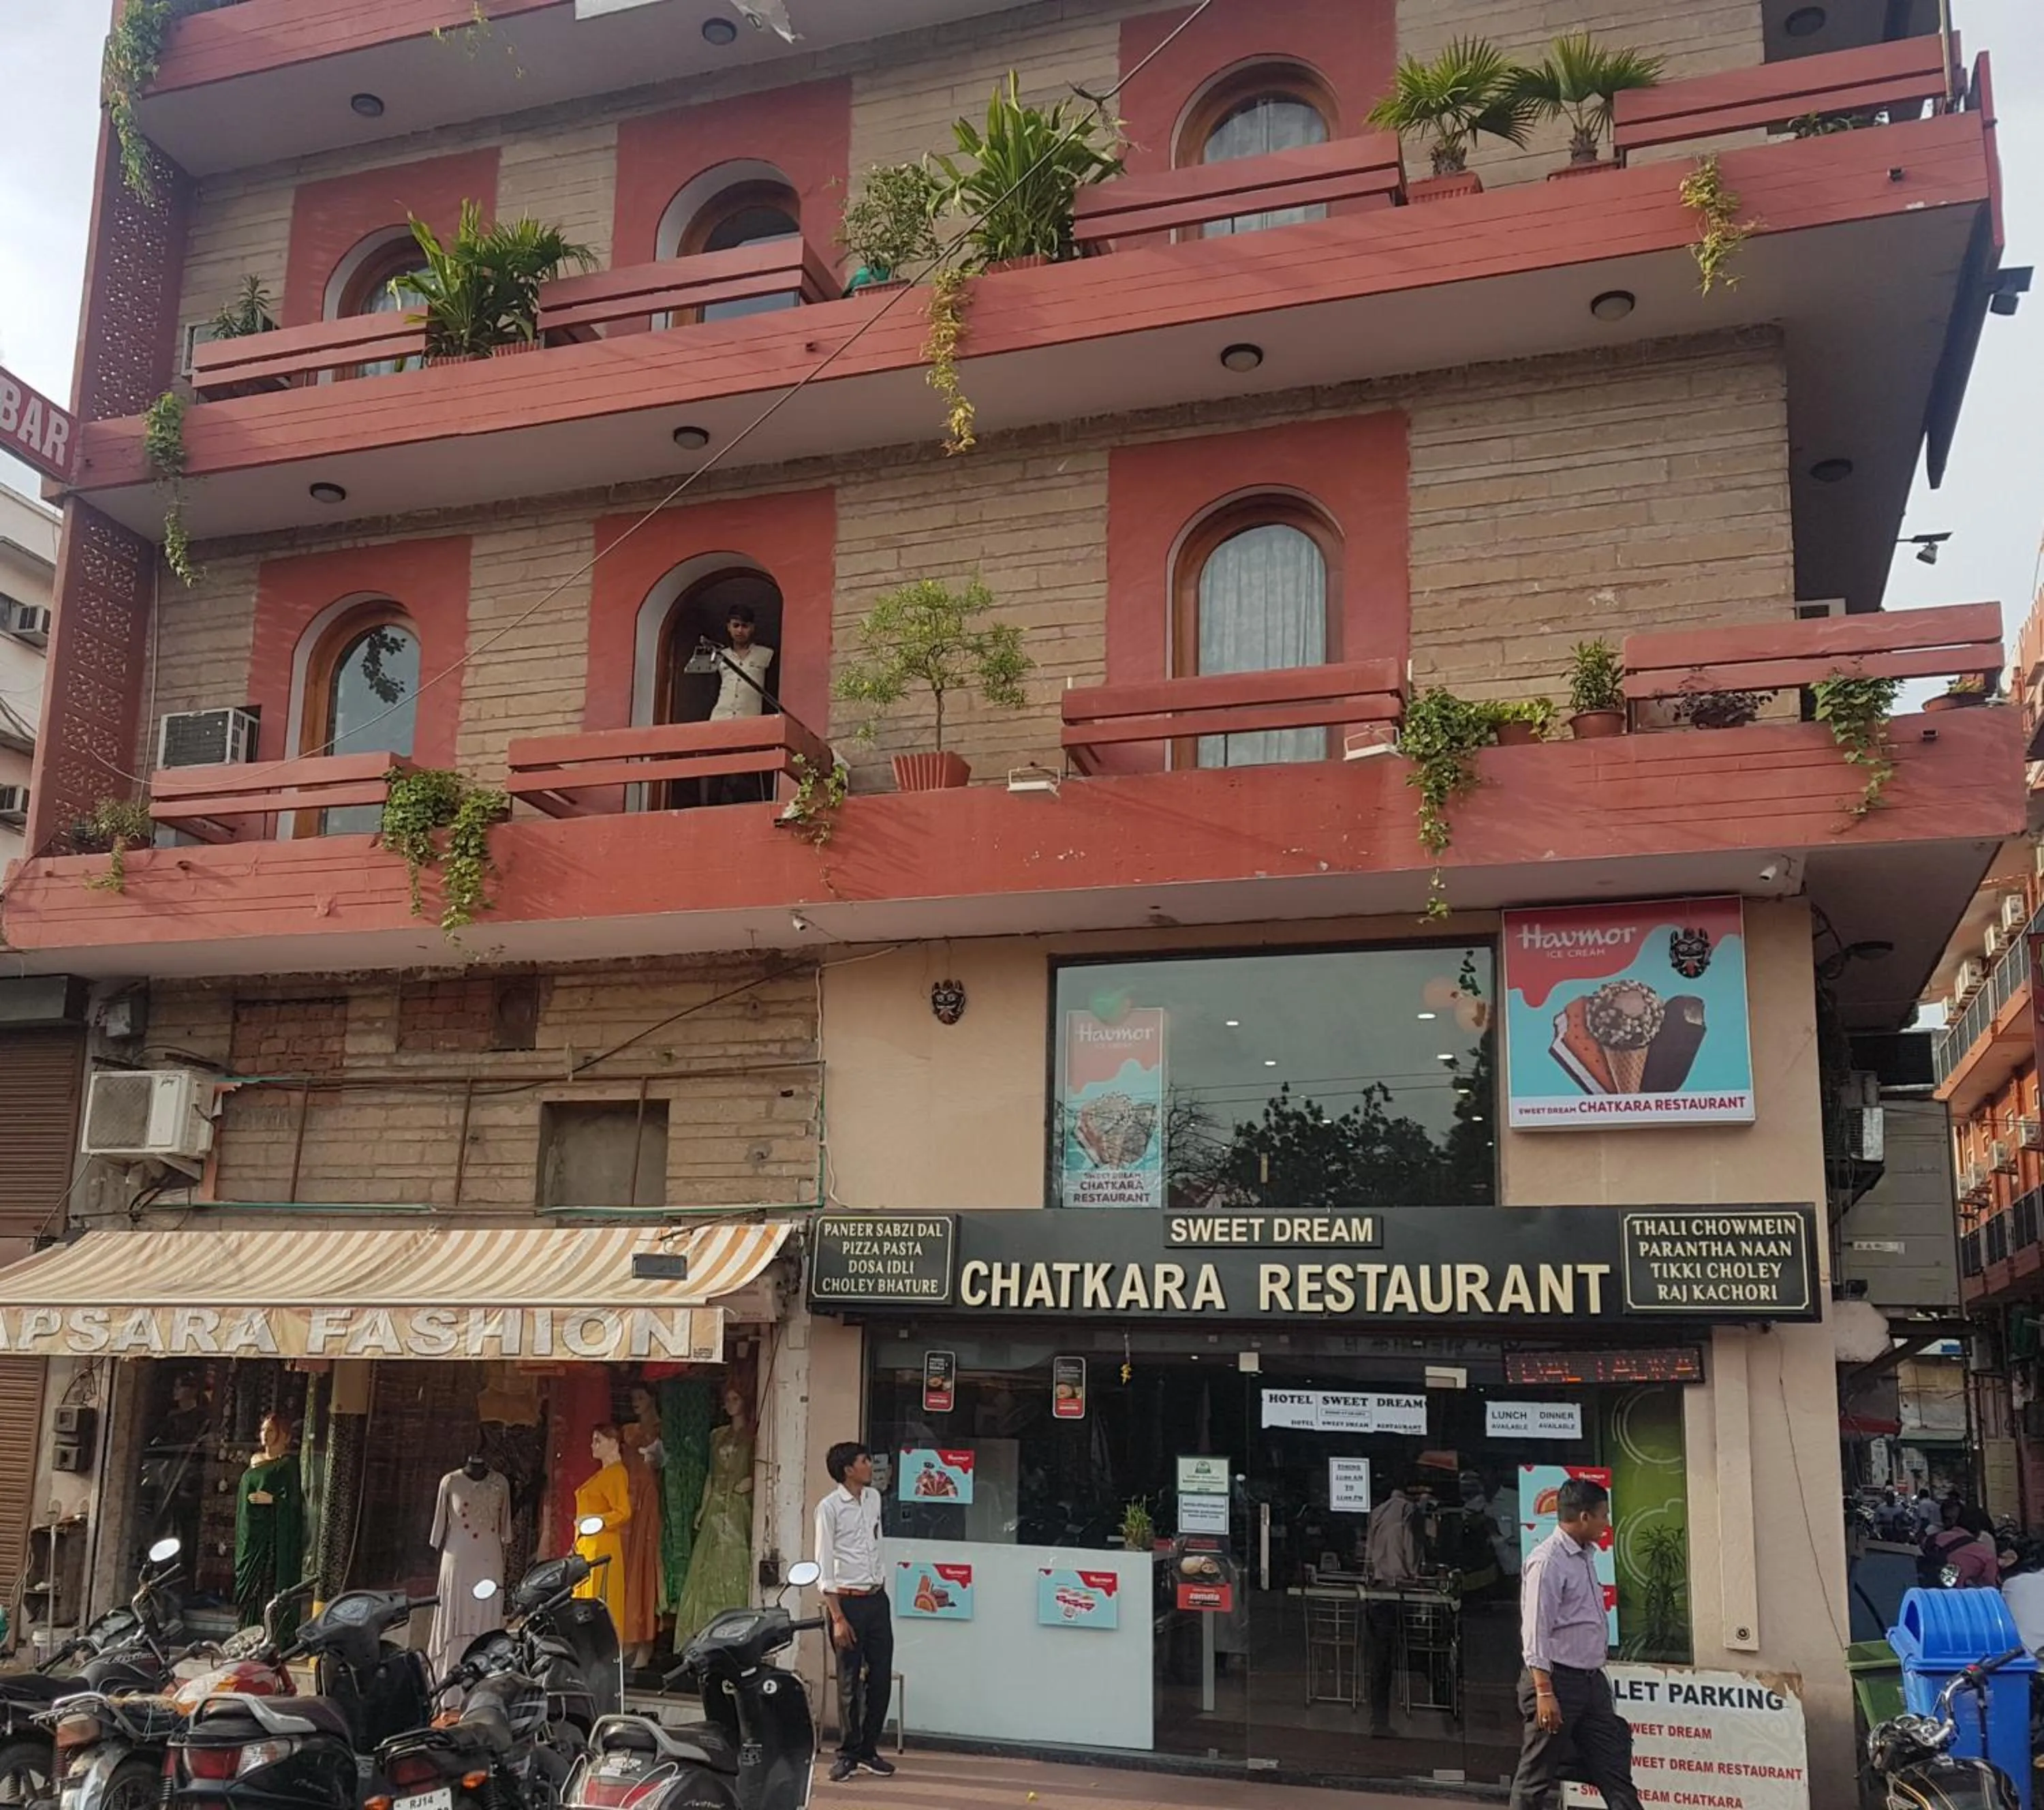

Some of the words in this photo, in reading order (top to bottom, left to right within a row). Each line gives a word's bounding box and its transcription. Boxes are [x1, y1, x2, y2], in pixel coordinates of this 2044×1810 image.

[0, 377, 69, 467] BAR
[1516, 923, 1637, 949] Havmor
[1547, 950, 1562, 959] ICE
[1568, 949, 1606, 958] CREAM
[1075, 1022, 1155, 1043] Havmor
[1547, 1107, 1577, 1115] DREAM
[1579, 1099, 1653, 1114] CHATKARA
[1656, 1096, 1746, 1111] RESTAURANT
[1080, 1180, 1144, 1191] CHATKARA
[1074, 1193, 1151, 1203] RESTAURANT
[824, 1223, 873, 1237] PANEER
[876, 1223, 914, 1237] SABZI
[918, 1223, 944, 1237] DAL
[1171, 1217, 1265, 1243] SWEET
[1273, 1217, 1374, 1242] DREAM
[1632, 1221, 1688, 1236] THALI
[1692, 1218, 1797, 1236] CHOWMEIN
[842, 1241, 880, 1255] PIZZA
[883, 1242, 923, 1256] PASTA
[1639, 1241, 1737, 1257] PARANTHA
[1741, 1241, 1793, 1257] NAAN
[848, 1259, 884, 1274] DOSA
[887, 1259, 914, 1275] IDLI
[1650, 1263, 1702, 1279] TIKKI
[1707, 1263, 1782, 1279] CHOLEY
[822, 1278, 875, 1292] CHOLEY
[878, 1278, 938, 1293] BHATURE
[961, 1260, 1227, 1310] CHATKARA
[1260, 1263, 1611, 1315] RESTAURANT
[1657, 1285, 1687, 1301] RAJ
[1692, 1285, 1778, 1301] KACHORI
[306, 1307, 692, 1358] FASHION
[1269, 1394, 1314, 1405] HOTEL
[1322, 1395, 1369, 1407] SWEET
[1377, 1398, 1423, 1409] DREAM
[1491, 1411, 1527, 1420] LUNCH
[1539, 1411, 1575, 1420] DINNER
[1614, 1678, 1660, 1702] LET
[1669, 1683, 1784, 1711] PARKING
[1628, 1722, 1664, 1736] WEET
[1669, 1725, 1712, 1739] DREAM
[1631, 1756, 1665, 1769] WEET
[1670, 1758, 1714, 1773] DREAM
[1718, 1762, 1803, 1780] RESTAURANT
[410, 1796, 434, 1809] RJ14
[1637, 1788, 1670, 1803] REAM
[1674, 1792, 1744, 1809] CHATKARA
